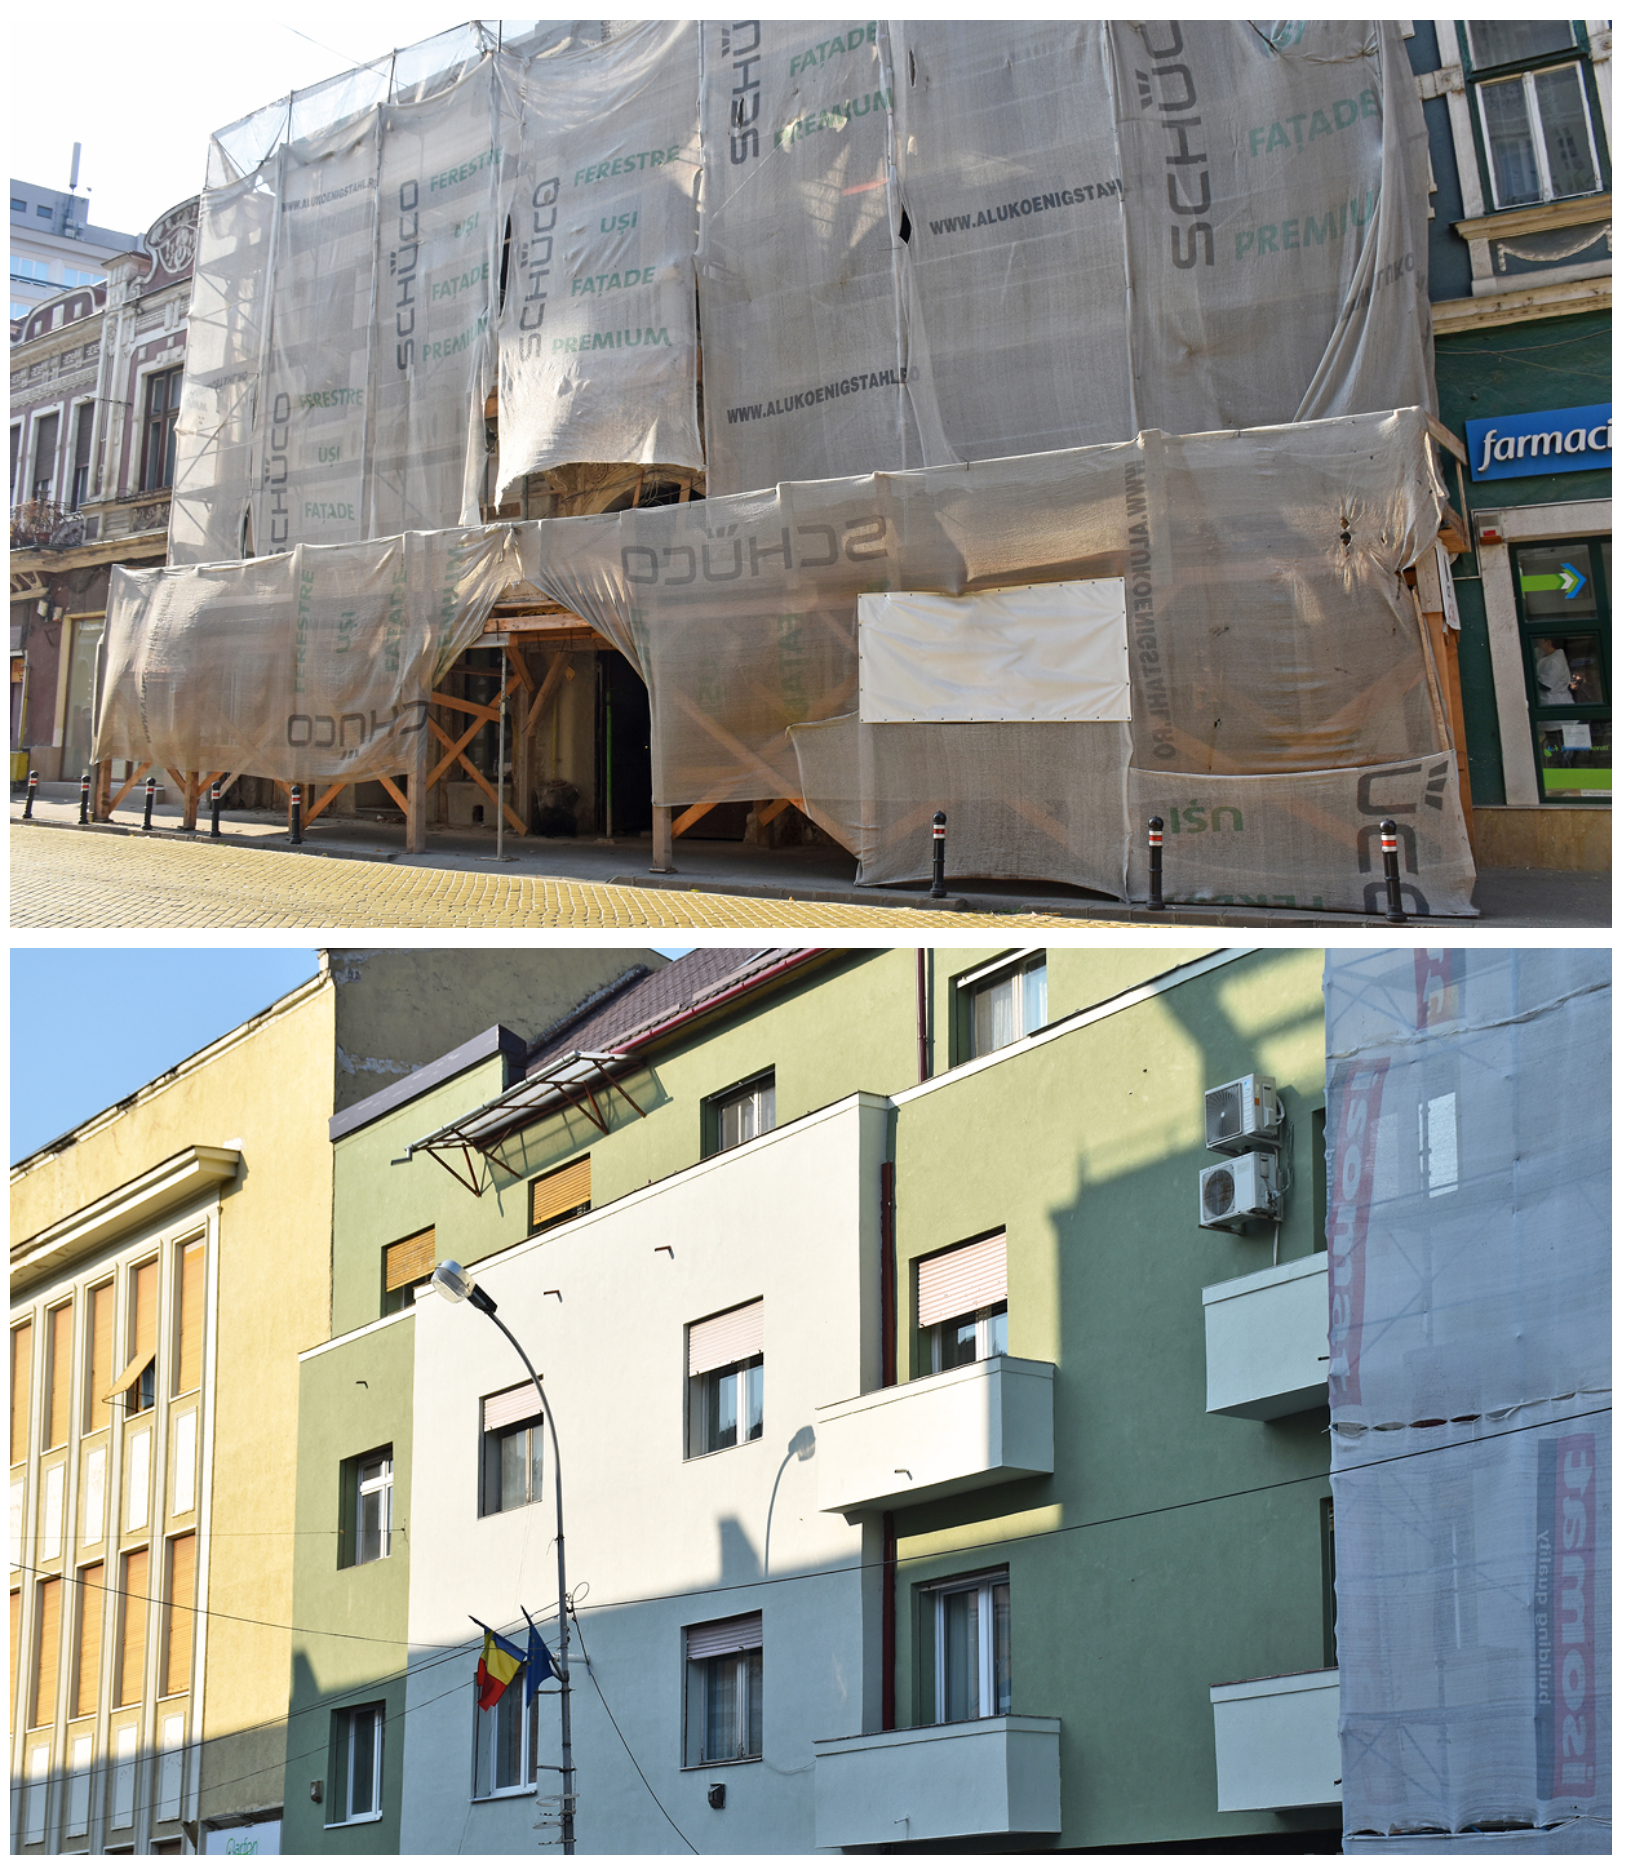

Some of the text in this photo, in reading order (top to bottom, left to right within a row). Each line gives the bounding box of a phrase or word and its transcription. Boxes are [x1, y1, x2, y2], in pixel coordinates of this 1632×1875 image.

[721, 20, 761, 166] SCHÜ
[1134, 20, 1215, 270] SCHÜC
[1235, 189, 1375, 261] PREMIU
[287, 700, 430, 761] CHÜCO
